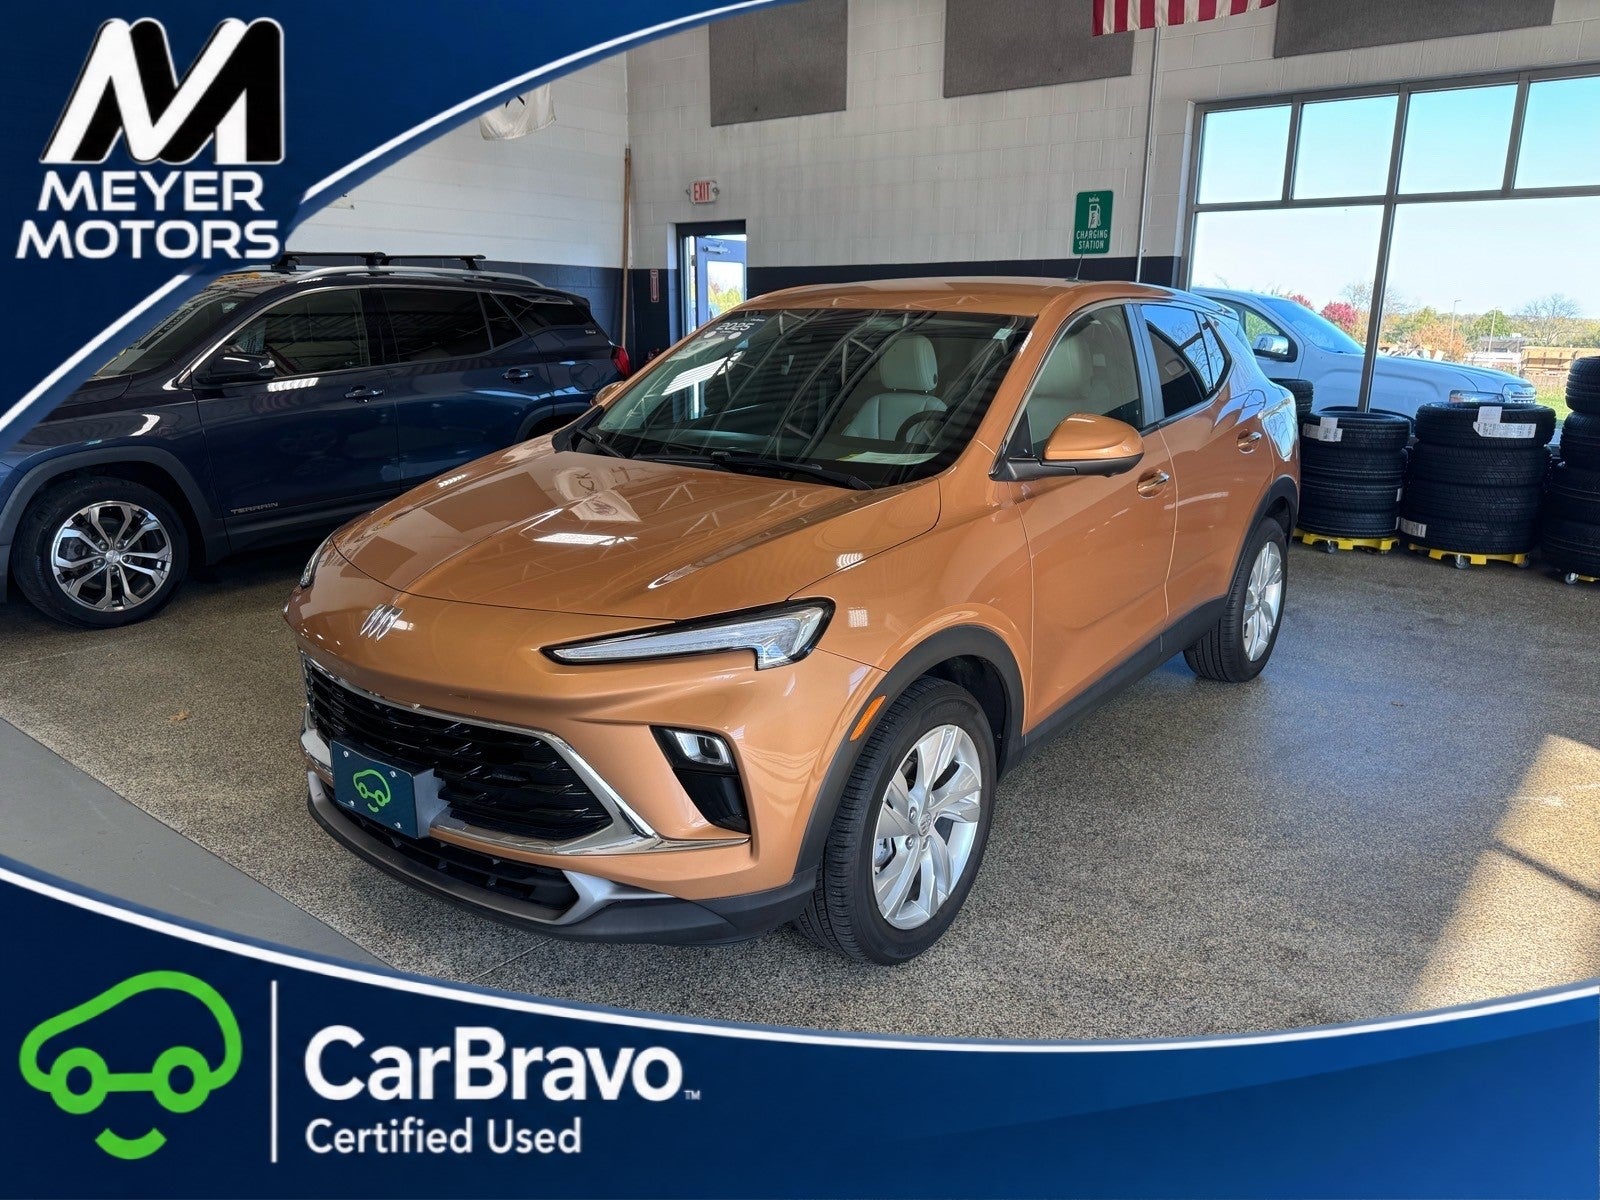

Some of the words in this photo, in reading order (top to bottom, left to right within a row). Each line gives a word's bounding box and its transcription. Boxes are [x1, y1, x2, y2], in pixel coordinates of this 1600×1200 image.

[693, 182, 711, 201] EXIT
[1076, 230, 1108, 240] CHARGING
[1078, 240, 1105, 250] STATION
[715, 322, 755, 331] 2025
[230, 502, 279, 514] TERRAIN
